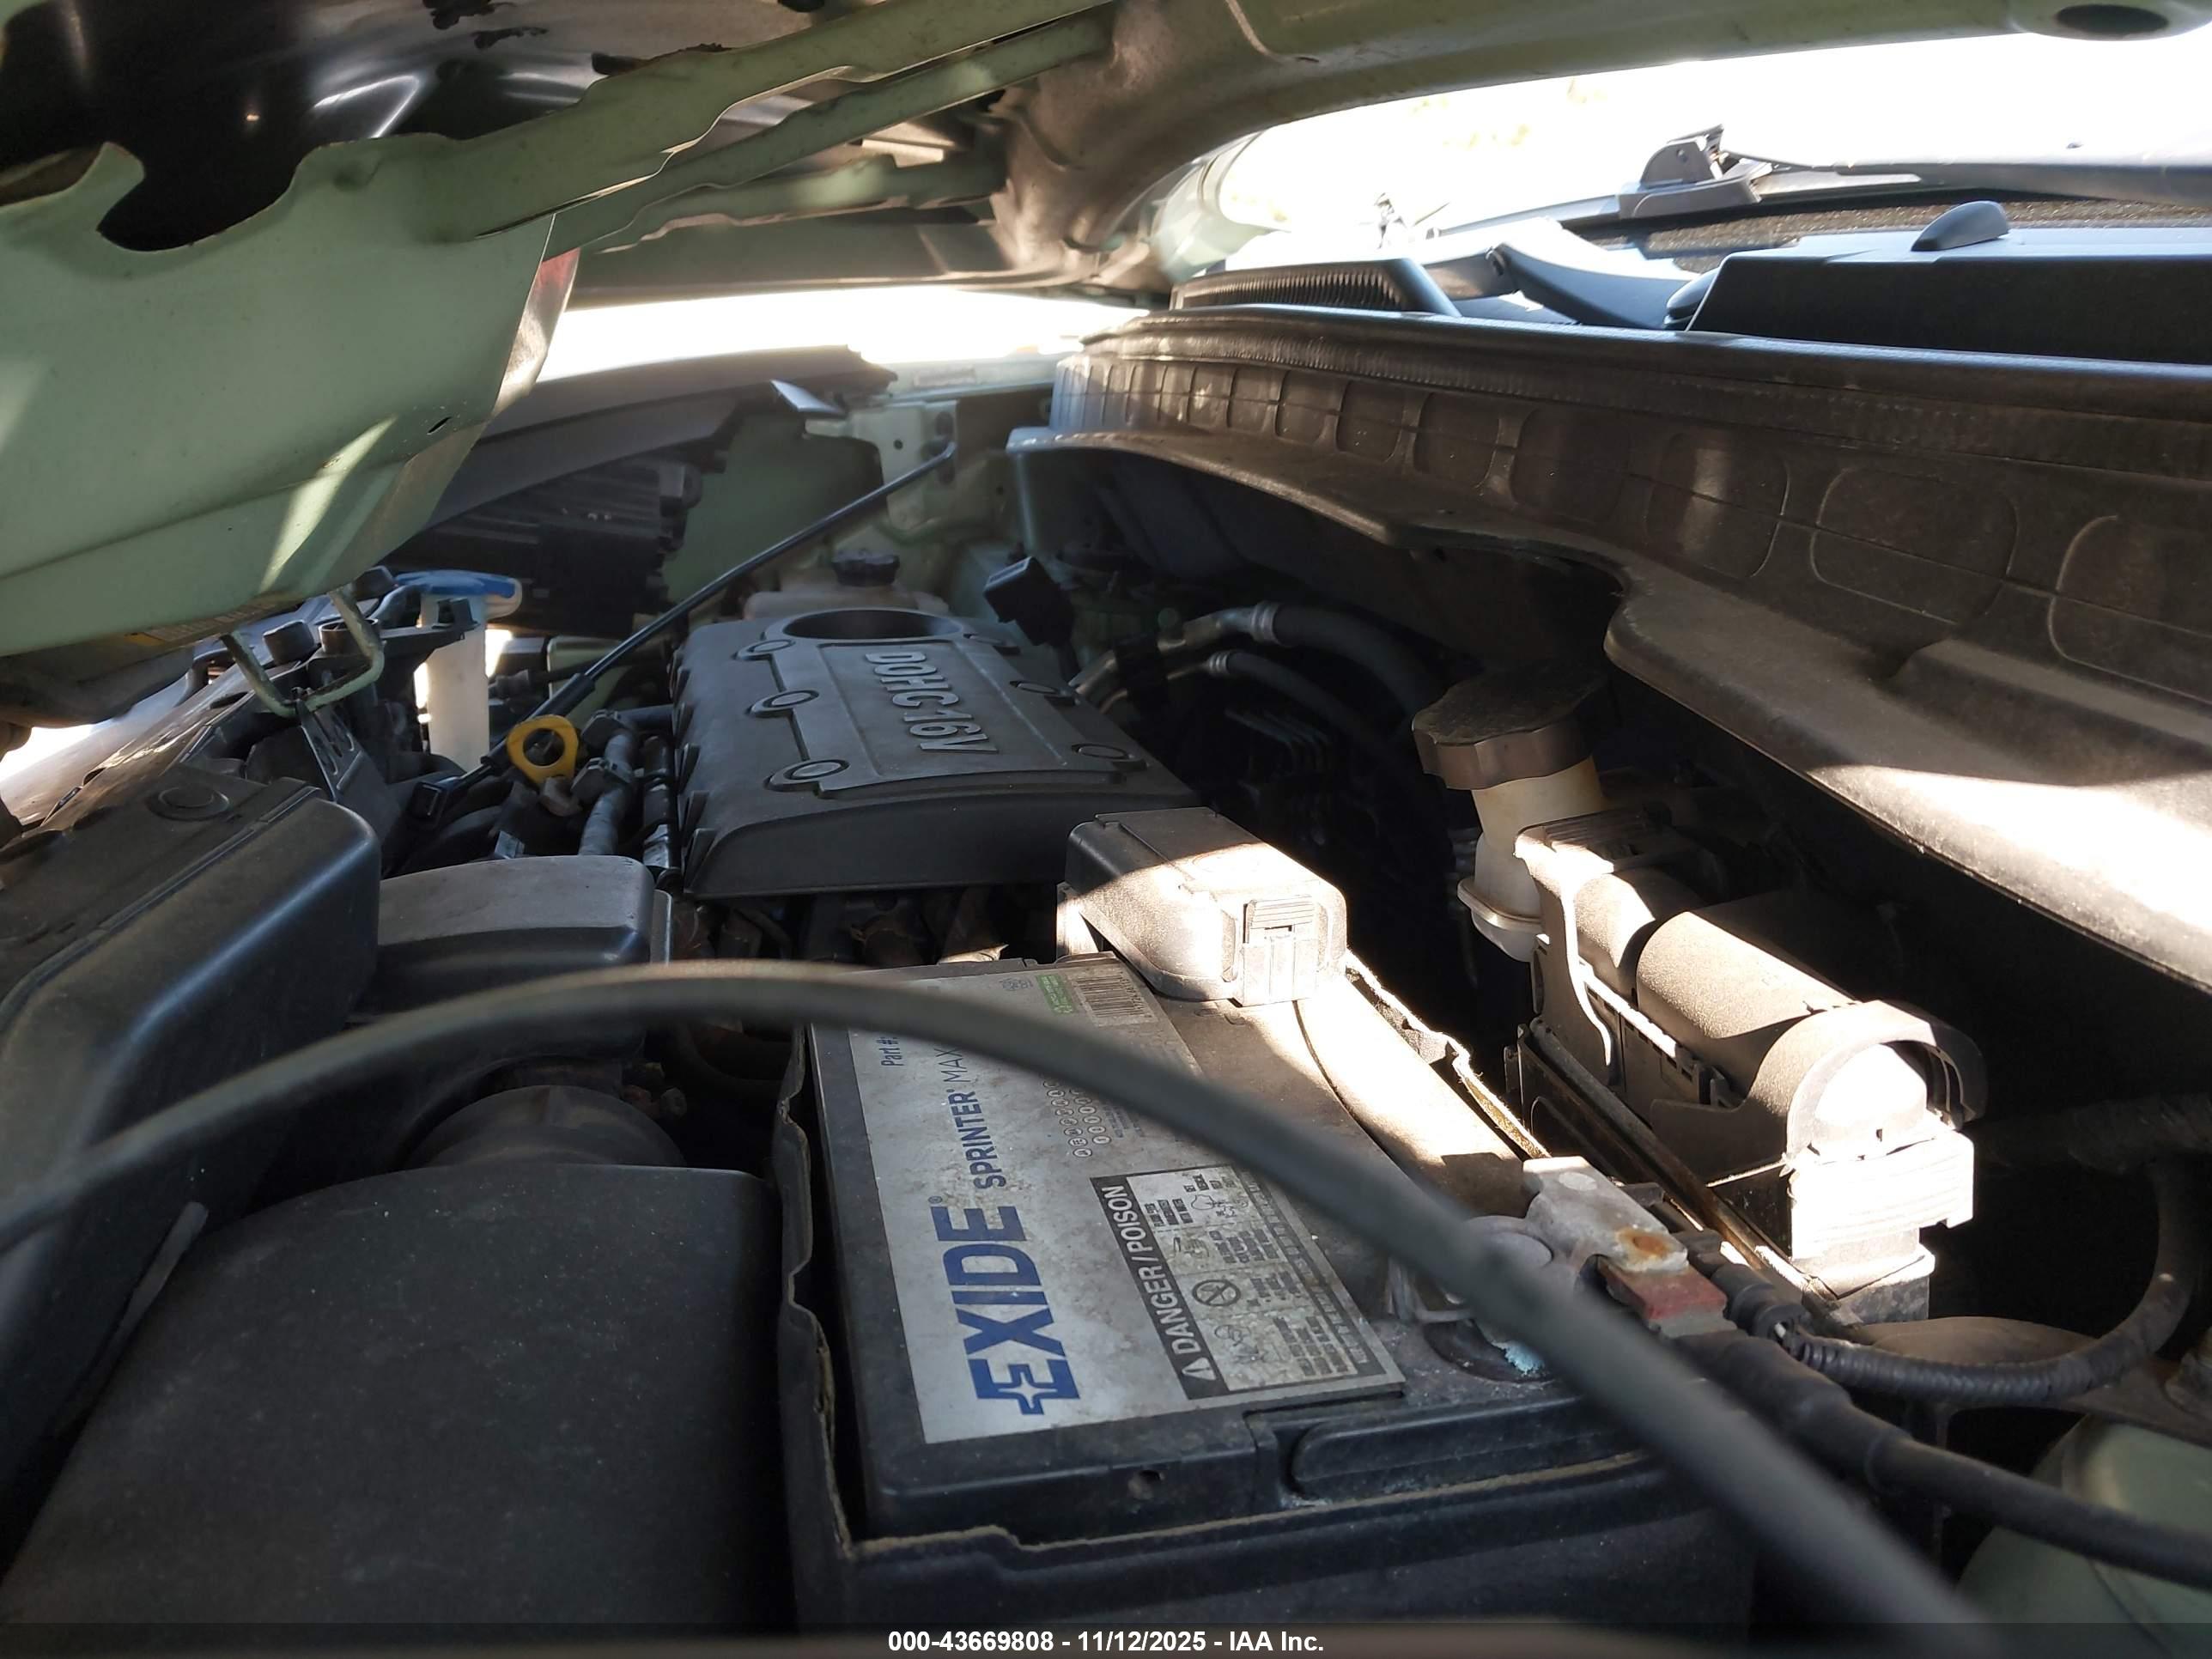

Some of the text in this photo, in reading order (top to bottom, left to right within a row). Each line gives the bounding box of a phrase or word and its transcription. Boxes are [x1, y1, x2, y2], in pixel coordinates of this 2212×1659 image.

[865, 651, 999, 752] DOHC 16V
[878, 1047, 904, 1066] Part
[933, 1048, 971, 1083] MAX
[930, 1206, 1080, 1415] EXIDE
